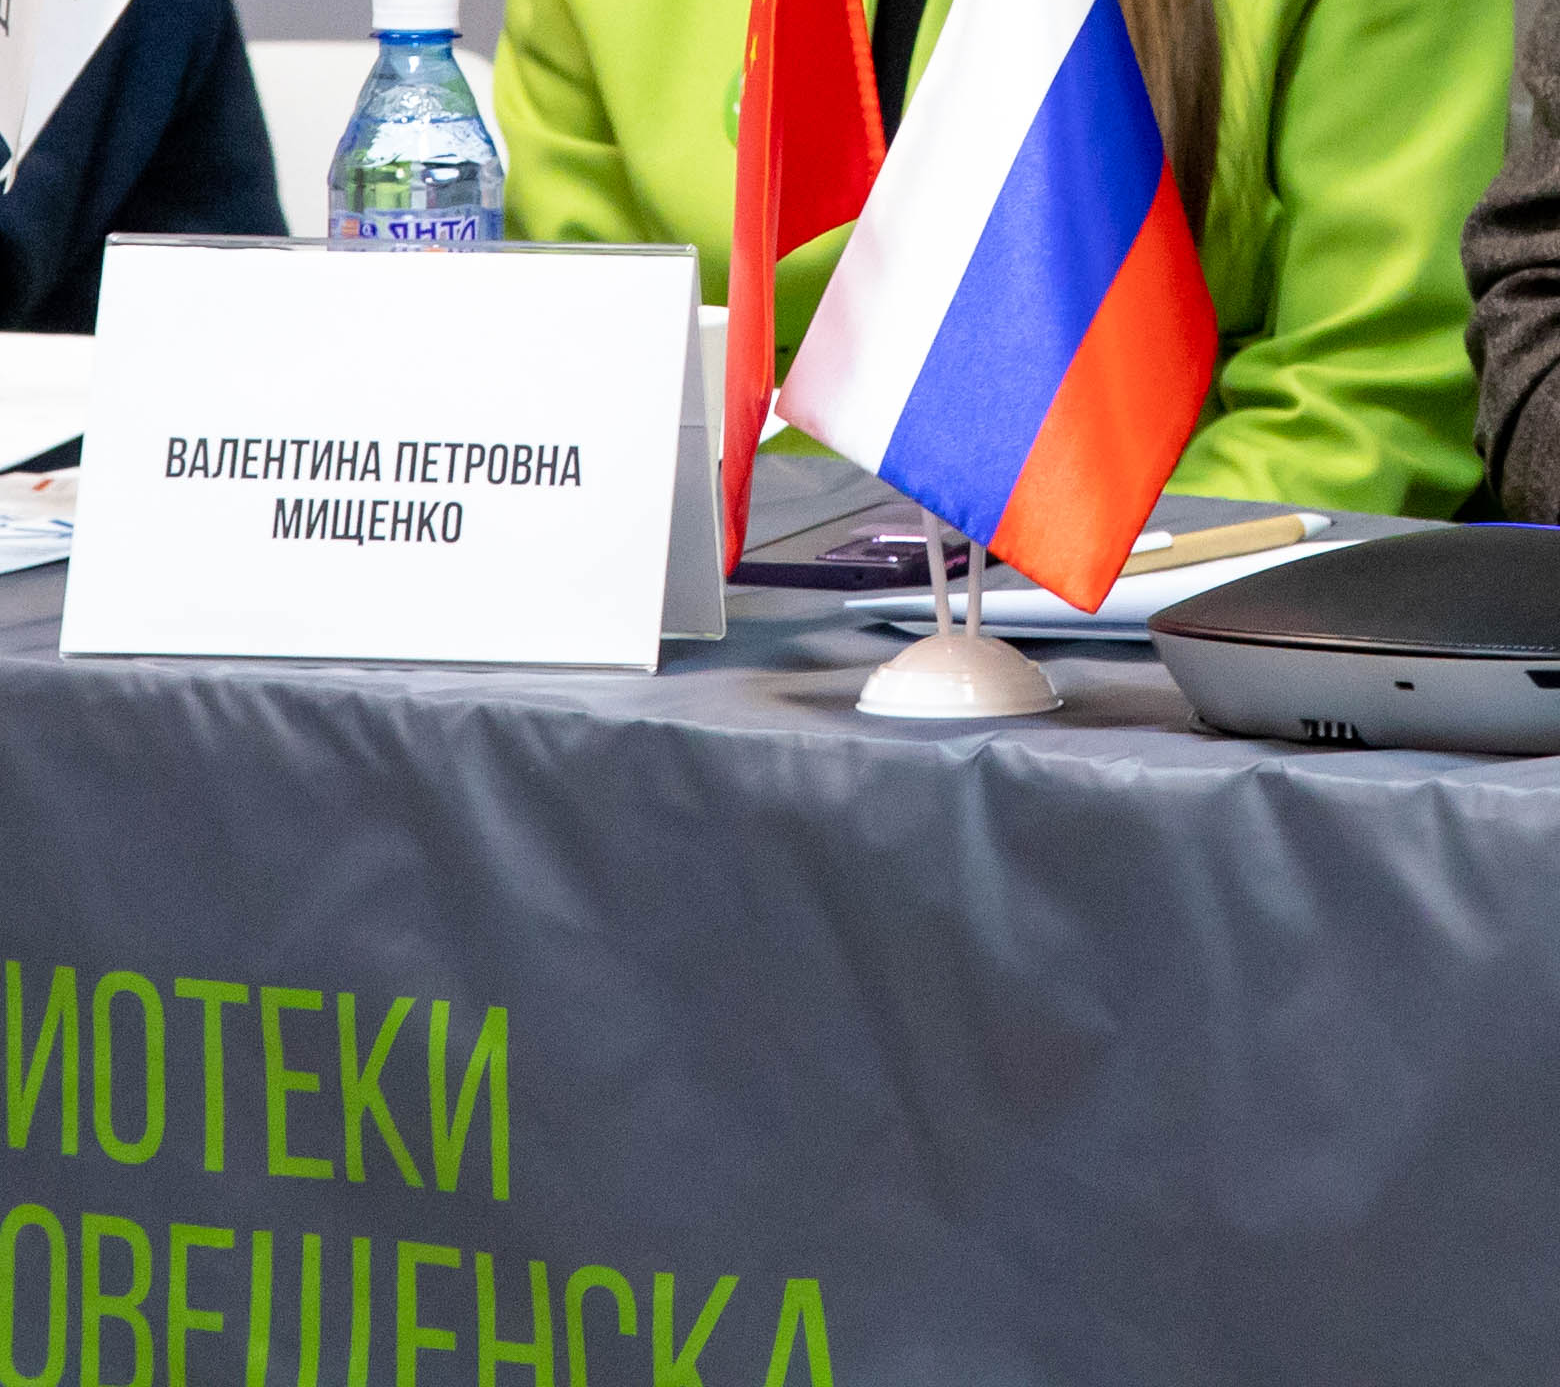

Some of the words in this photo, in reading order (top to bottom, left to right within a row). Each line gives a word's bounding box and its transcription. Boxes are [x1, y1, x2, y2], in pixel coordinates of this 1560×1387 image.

[165, 436, 382, 483] ВАЛЕНТИНА
[394, 441, 582, 489] ПЕТРОВНА
[272, 497, 464, 547] МИЩЕНКО
